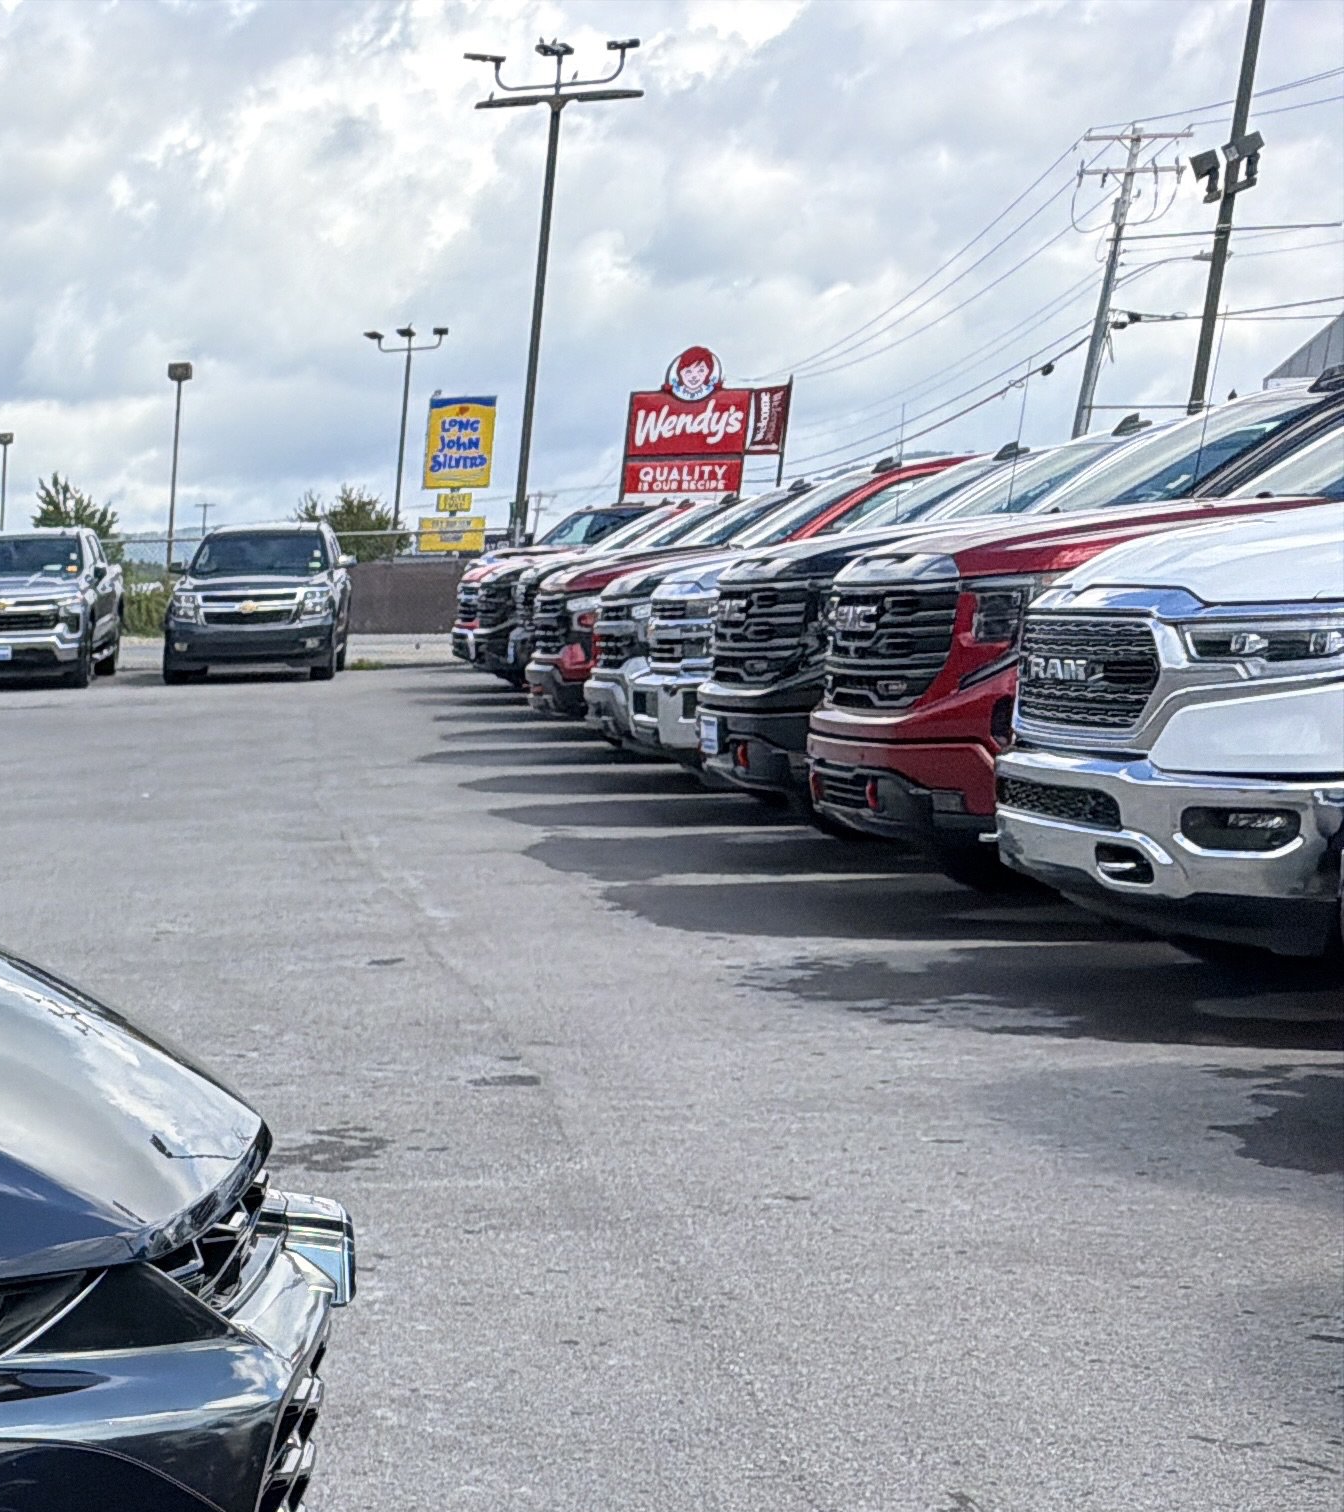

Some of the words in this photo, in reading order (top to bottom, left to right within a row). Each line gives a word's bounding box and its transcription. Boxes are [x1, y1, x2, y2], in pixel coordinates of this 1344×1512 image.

[441, 418, 481, 433] LONG
[635, 399, 744, 447] Wendy's
[639, 465, 728, 482] QUALITY
[638, 480, 649, 491] IS
[653, 480, 678, 490] OUR
[682, 479, 726, 490] RECIPE
[1029, 656, 1088, 681] RAM
